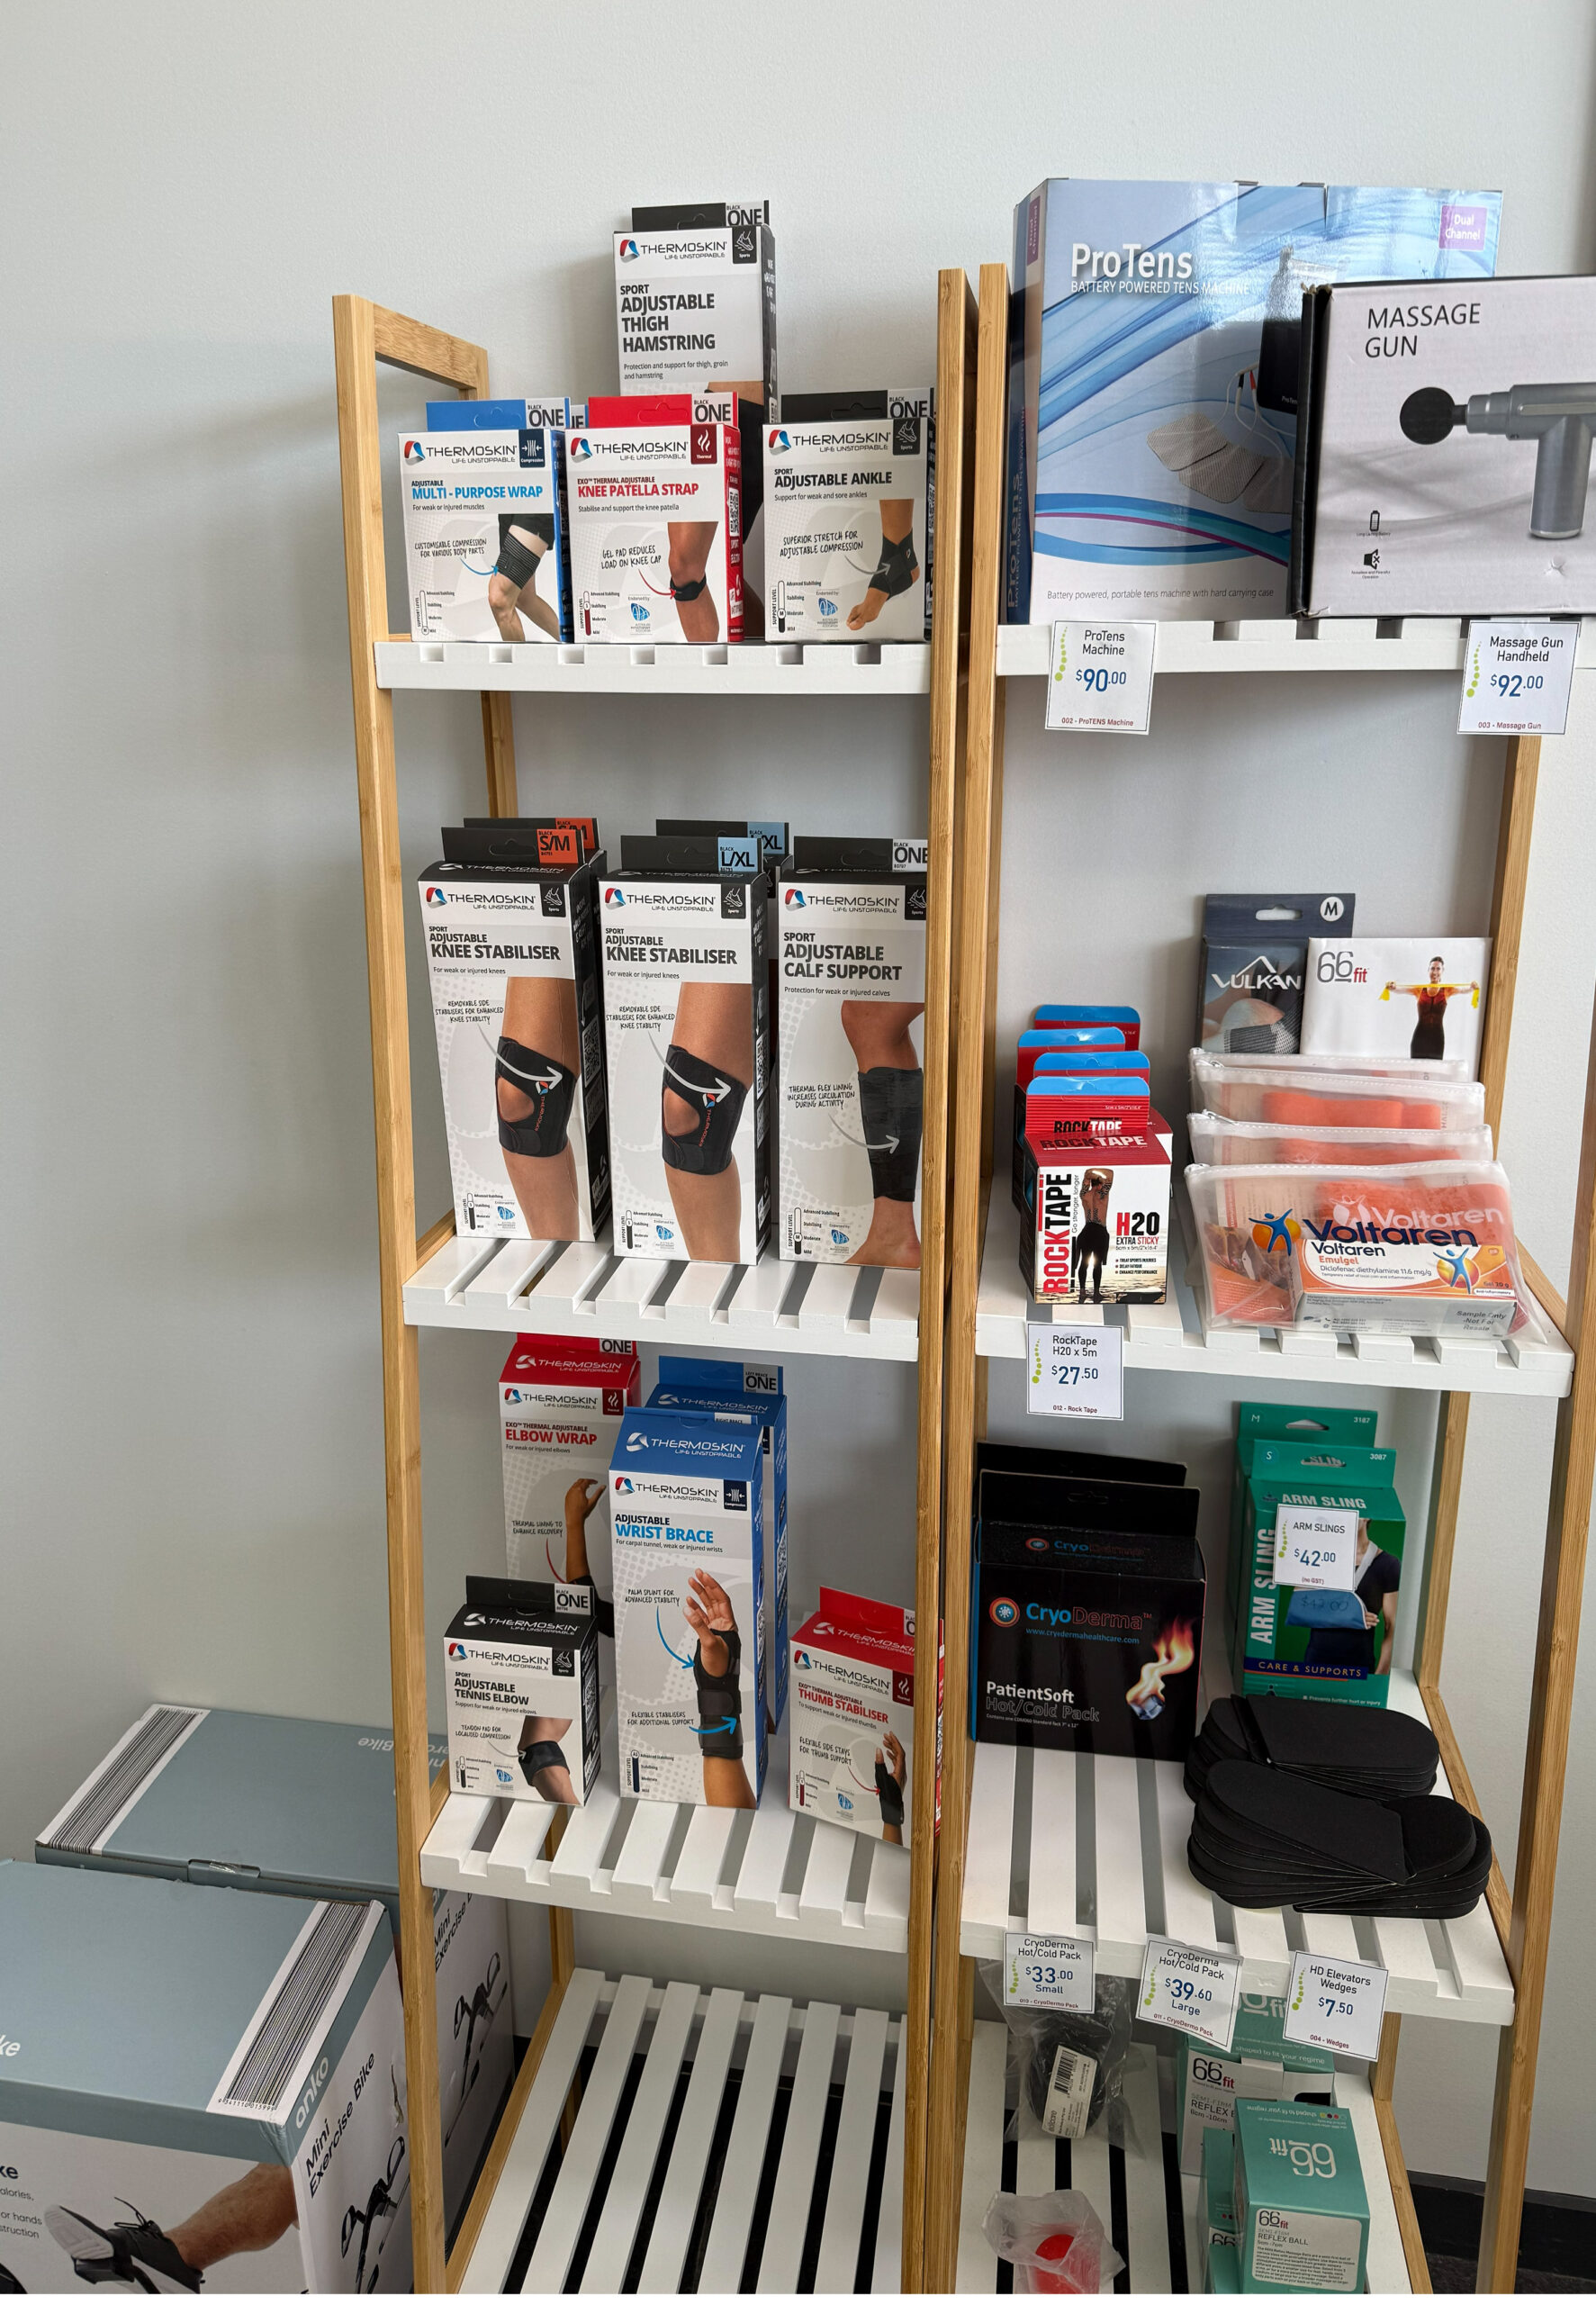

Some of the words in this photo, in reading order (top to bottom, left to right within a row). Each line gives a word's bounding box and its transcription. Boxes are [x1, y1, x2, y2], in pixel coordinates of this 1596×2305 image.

[728, 209, 762, 225] ONE
[1455, 214, 1474, 226] Dual
[1446, 229, 1481, 240] Channel
[641, 241, 726, 254] THERMOSKIN
[1071, 243, 1192, 279] ProTens
[620, 285, 649, 294] SPORT
[1071, 281, 1116, 293] BATTERY
[1119, 281, 1170, 293] POWERED
[1174, 281, 1199, 294] TENS
[1202, 282, 1249, 294] MACHINE
[621, 294, 715, 315] ADJUSTABLE
[1368, 303, 1481, 329] MASSAGE
[622, 316, 669, 332] THIGH
[624, 334, 715, 352] HAMSTRING
[1366, 336, 1417, 358] GUN
[664, 362, 685, 371] support
[714, 360, 728, 368] groin
[695, 404, 731, 422] ONE
[890, 401, 927, 418] ONE
[529, 409, 563, 427] ONE
[793, 432, 890, 446] THERMOSKIN
[426, 446, 517, 456] THERMOSKIN
[593, 442, 688, 454] THERMOSKIN
[775, 474, 847, 490] ADJUSTABLE
[851, 472, 892, 484] ANKLE
[412, 488, 446, 500] MULTI
[455, 487, 505, 499] PURPOSE
[508, 486, 543, 498] WRAP
[578, 486, 607, 498] KNEE
[610, 484, 660, 497] PATELLA
[662, 484, 699, 495] STRAP
[444, 503, 462, 511] injured
[603, 549, 613, 558] GEL
[616, 548, 627, 556] PAD
[629, 546, 655, 556] REDUCES
[601, 560, 617, 569] LOAD
[618, 559, 628, 567] ON
[631, 557, 648, 566] KNEE
[650, 556, 661, 565] CAP
[1048, 590, 1072, 600] Battery
[1075, 590, 1109, 601] powered,
[1112, 589, 1141, 600] portable
[1144, 590, 1158, 598] tens
[1161, 588, 1191, 597] machine
[1193, 588, 1207, 597] with
[1210, 588, 1225, 597] hard
[1229, 588, 1256, 598] carrying
[1258, 589, 1274, 597] case
[1085, 629, 1124, 641] ProTens
[1083, 644, 1124, 655] Machine
[1490, 636, 1537, 650] Massage
[1542, 637, 1563, 647] Gun
[1498, 650, 1549, 661] Handheld
[1076, 669, 1126, 692] $90.00
[1491, 674, 1543, 697] $92.00
[540, 836, 570, 851] S/M
[721, 852, 754, 867] L/XL
[447, 894, 536, 904] THERMOSKIN
[627, 895, 716, 905] THERMOSKIN
[807, 896, 899, 907] THERMOSKIN
[1324, 902, 1338, 916] M
[429, 934, 487, 944] ADJUSTABLE
[606, 936, 663, 946] ADJUSTABLE
[432, 945, 472, 958] KNEE
[475, 945, 560, 961] STABILISER
[607, 947, 646, 962] KNEE
[650, 948, 737, 964] STABILISER
[784, 944, 884, 963] ADJUSTABLE
[785, 963, 824, 978] CALF
[827, 964, 902, 980] SUPPORT
[1211, 956, 1302, 990] VULKAN
[1116, 1212, 1159, 1236] H20
[1371, 1207, 1504, 1229] Voltaren
[1303, 1219, 1478, 1247] Voltaren
[1116, 1237, 1136, 1245] EXTRA
[1138, 1236, 1159, 1244] STICKY
[1311, 1242, 1385, 1256] Voltaren
[1319, 1256, 1358, 1265] Emulgel
[1321, 1265, 1355, 1273] Diclofenac
[1413, 1269, 1431, 1277] mg/g
[601, 1340, 632, 1353] ONE
[1053, 1335, 1097, 1347] RockTape
[1053, 1347, 1070, 1355] H20
[1083, 1348, 1096, 1357] 5m
[1051, 1365, 1098, 1385] $27.50
[523, 1394, 598, 1404] THERMOSKIN
[506, 1429, 554, 1443] ELBOW
[556, 1433, 597, 1445] WRAP
[652, 1439, 745, 1452] THERMOSKIN
[1267, 1451, 1272, 1460] S
[1282, 1494, 1317, 1505] ARM
[1321, 1496, 1366, 1509] SLING
[615, 1514, 670, 1525] ADJUSTABLE
[616, 1523, 661, 1539] WRIST
[666, 1528, 713, 1543] BRACE
[1294, 1522, 1312, 1530] ARM
[1314, 1523, 1345, 1533] SLINGS
[1294, 1549, 1336, 1568] $42.00
[557, 1594, 589, 1608] ONE
[468, 1650, 550, 1664] THERMOSKIN
[1258, 1661, 1288, 1671] CARE
[1305, 1666, 1361, 1677] SUPPORTS
[455, 1678, 516, 1693] ADJUSTABLE
[987, 1681, 1074, 1704] PatientSoft
[455, 1689, 491, 1702] TENNIS
[493, 1693, 529, 1705] ELBOW
[798, 1688, 834, 1708] THUMB
[835, 1700, 888, 1723] STABILISER
[986, 1696, 1058, 1717] Hot/Cold
[1062, 1705, 1099, 1722] Pack
[1024, 1939, 1075, 1950] CryoDerma
[1018, 1948, 1057, 1957] Hot/Cold
[1059, 1950, 1081, 1960] Pack
[1025, 1966, 1073, 1984] $33.00
[1310, 1966, 1324, 1975] HD
[1327, 1969, 1370, 1986] Elevators
[1035, 1984, 1063, 1994] Small
[1165, 1978, 1212, 2002] $39.60
[1321, 1978, 1357, 1994] Wedges
[1171, 2000, 1200, 2016] Large
[1318, 1997, 1353, 2017] $7.50
[296, 2056, 329, 2129] anko
[310, 2102, 353, 2199] Exercise
[354, 2053, 374, 2100] Bike
[306, 2119, 329, 2177] Mini
[1258, 2233, 1286, 2242] REFLEX
